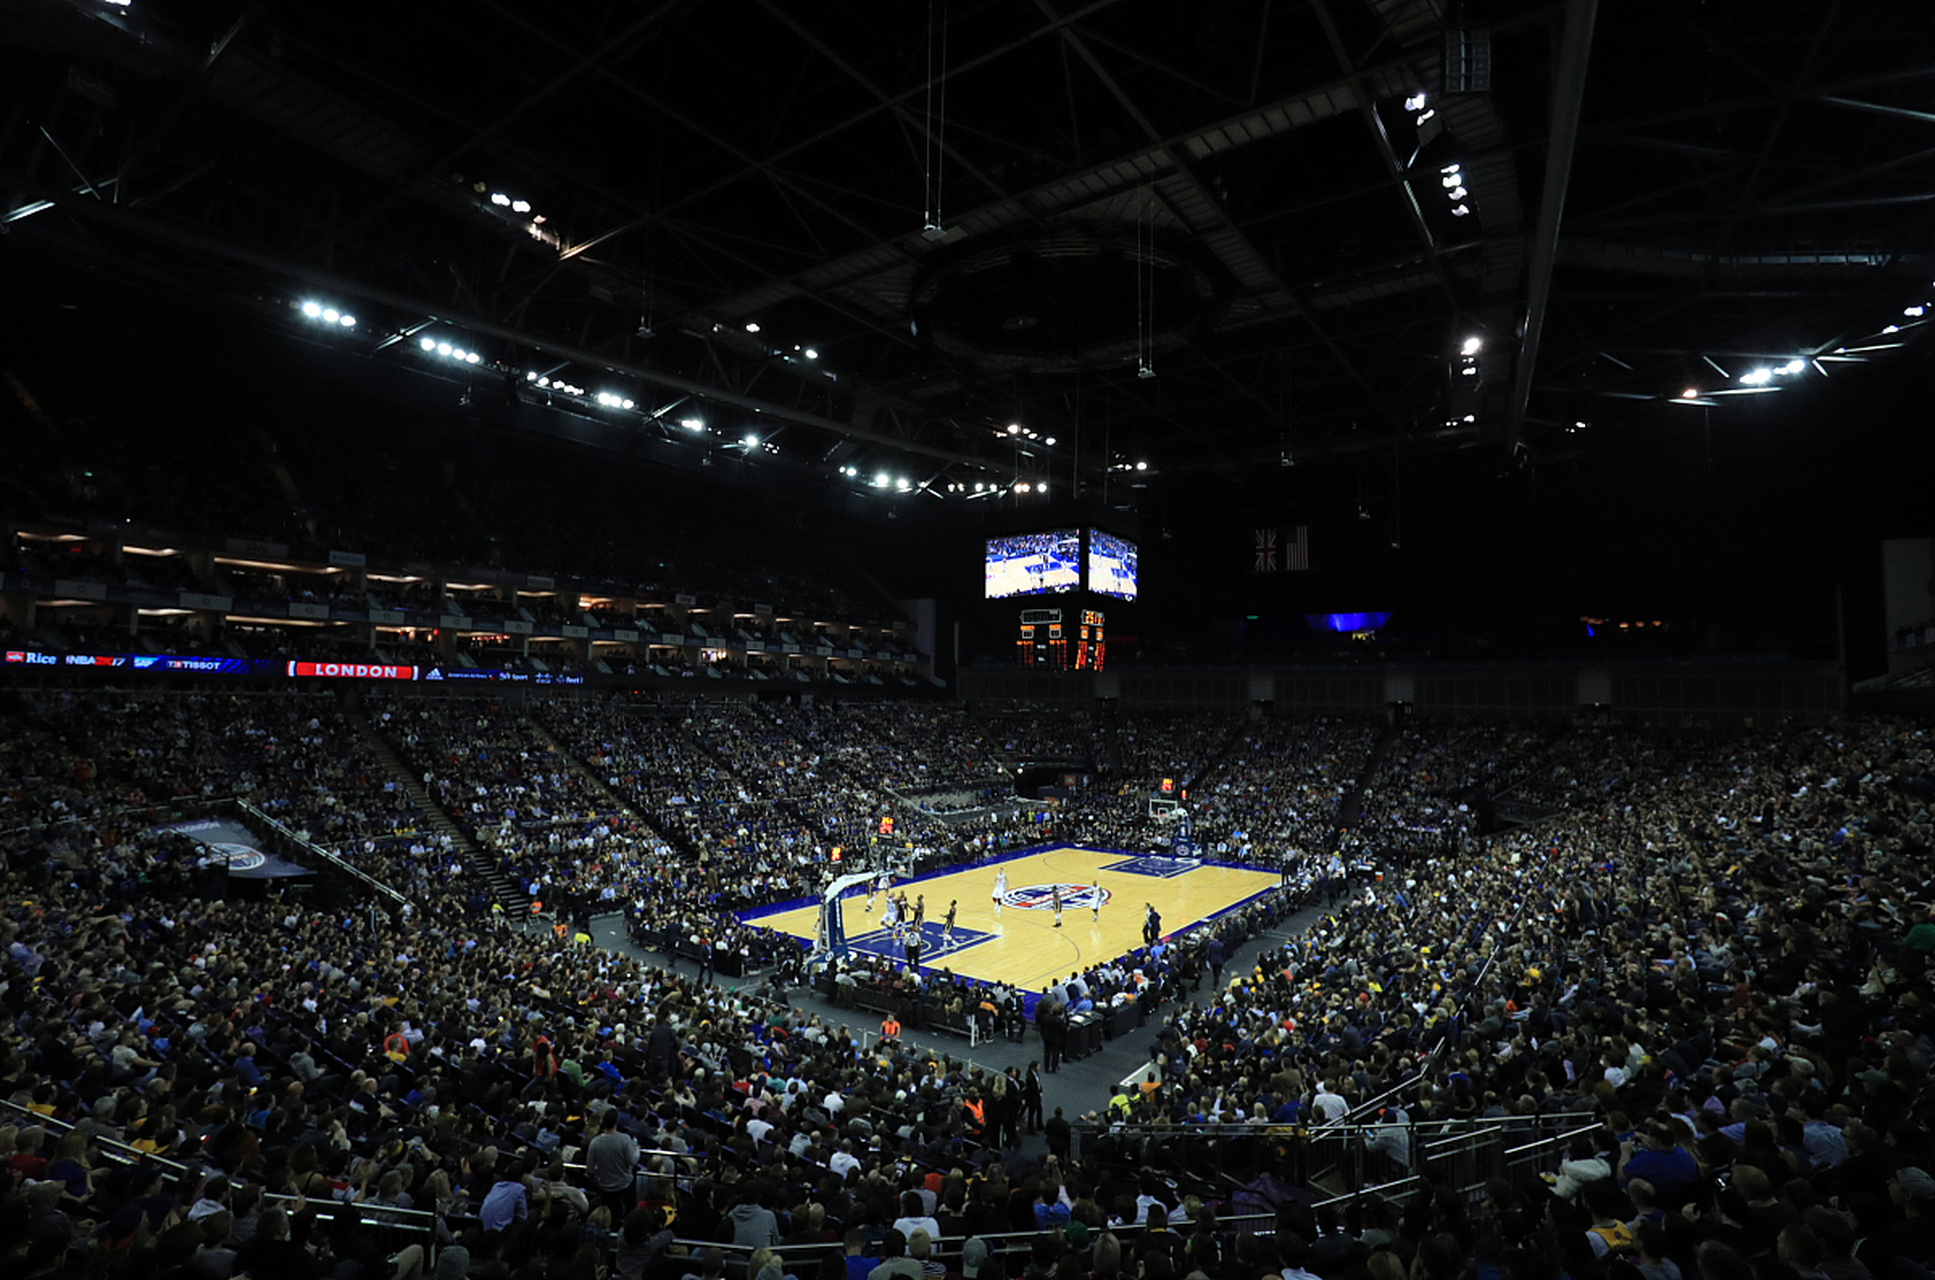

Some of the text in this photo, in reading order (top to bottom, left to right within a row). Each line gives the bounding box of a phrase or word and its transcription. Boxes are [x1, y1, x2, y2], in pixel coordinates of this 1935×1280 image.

[26, 652, 58, 665] Rice
[182, 661, 222, 670] TISSOT
[315, 664, 398, 678] LONDON
